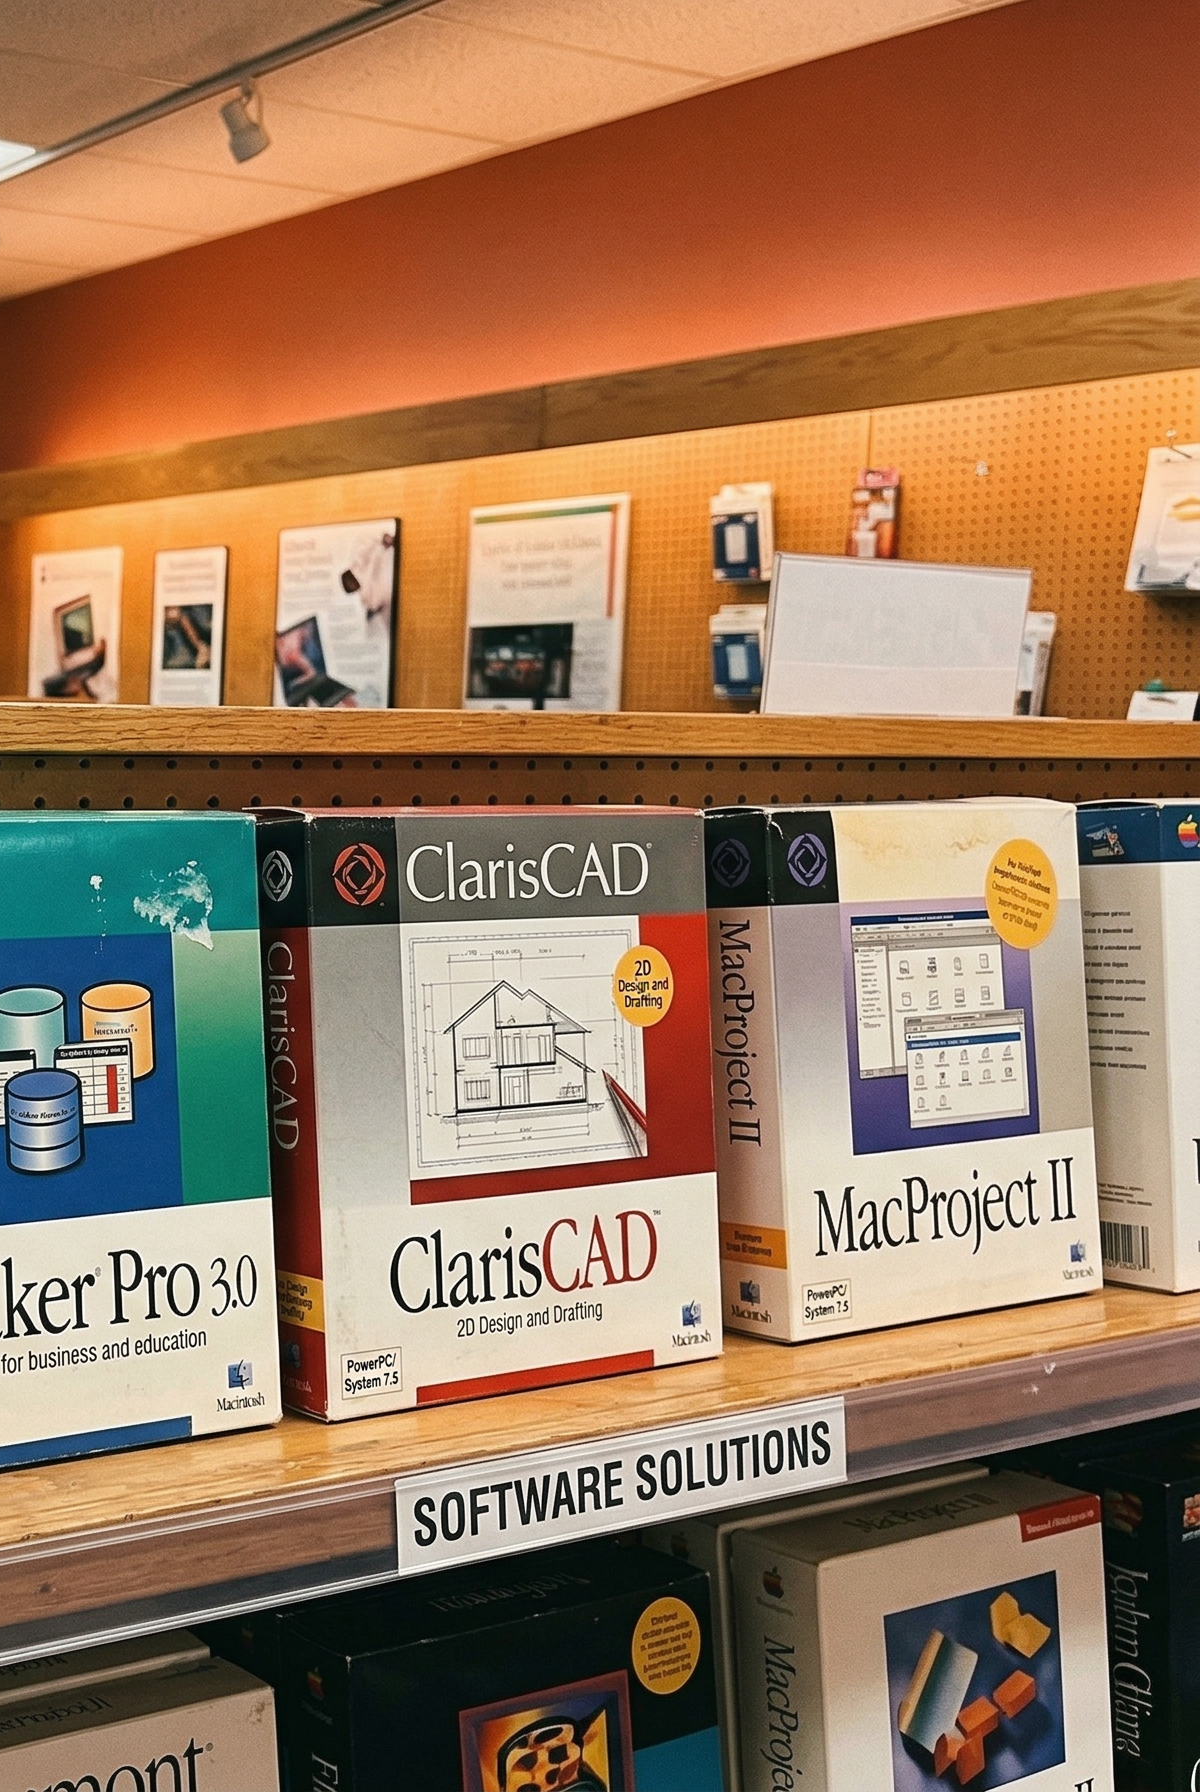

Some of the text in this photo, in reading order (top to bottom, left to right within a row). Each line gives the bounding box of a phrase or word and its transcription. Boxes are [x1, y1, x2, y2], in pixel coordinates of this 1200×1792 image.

[618, 977, 669, 994] Design and
[634, 959, 651, 976] 2D
[625, 993, 663, 1010] Drafting
[266, 940, 299, 1151] ClarisCAD
[718, 919, 763, 1147] MacProject II
[813, 1156, 1077, 1256] MacProject II
[389, 1209, 659, 1314] ClarisCAD
[107, 1248, 201, 1326] Pro
[210, 1254, 259, 1318] 3.0
[457, 1300, 604, 1338] 2D Design and Drafting
[805, 1304, 835, 1321] System
[1, 1354, 24, 1376] for
[28, 1344, 97, 1373] business
[101, 1340, 131, 1362] and
[134, 1328, 208, 1357] education
[347, 1352, 397, 1373] PowerPC/
[344, 1371, 399, 1395] System 7.5
[413, 1420, 832, 1547] SOFTWARE SOLUTIONS
[760, 1634, 803, 1792] MacProje
